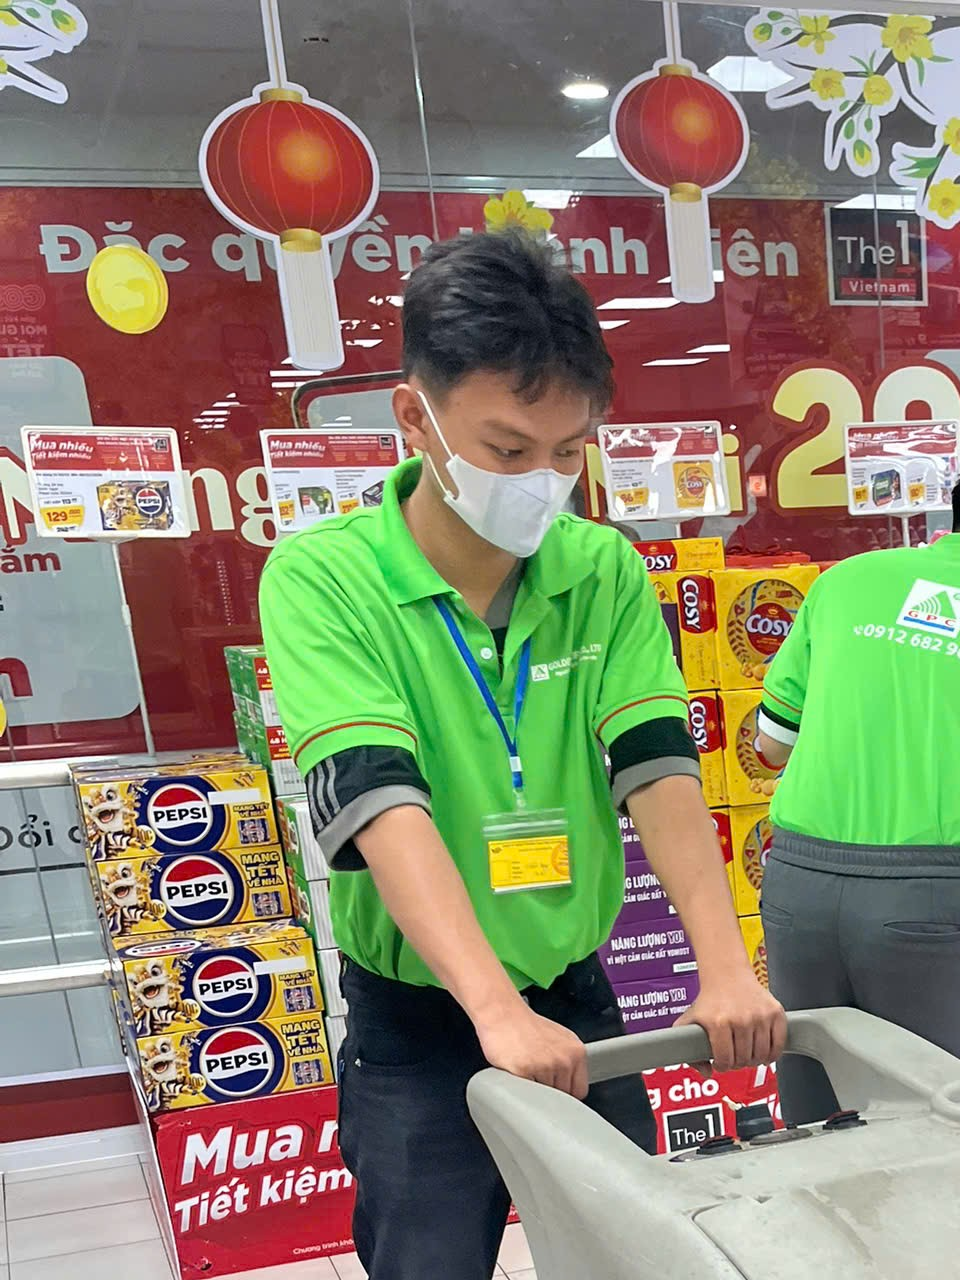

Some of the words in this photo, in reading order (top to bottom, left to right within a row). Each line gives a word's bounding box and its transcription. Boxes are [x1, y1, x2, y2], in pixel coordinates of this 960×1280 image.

[711, 228, 799, 277] iên
[849, 281, 911, 294] Vietnam
[46, 510, 69, 523] 129
[681, 578, 701, 629] COSY
[745, 613, 795, 637] COSY
[863, 624, 908, 645] 0912
[910, 633, 944, 652] 682
[689, 700, 709, 750] COSY
[153, 806, 208, 823] PEPSI
[241, 852, 280, 865] MANG
[247, 862, 278, 878] TẾT
[166, 881, 229, 900] PEPSI
[637, 932, 667, 949] LƯỢNG
[199, 978, 254, 995] PEPSI
[639, 990, 669, 1007] LƯỢNG
[281, 1020, 321, 1034] MANG
[287, 1029, 319, 1046] TẾT
[206, 1052, 269, 1073] PEPSI
[669, 1077, 719, 1102] cho
[181, 1124, 304, 1185] Mua
[174, 1177, 250, 1233] Tiết
[259, 1165, 353, 1206] kiệm
[340, 1238, 355, 1249] khô
